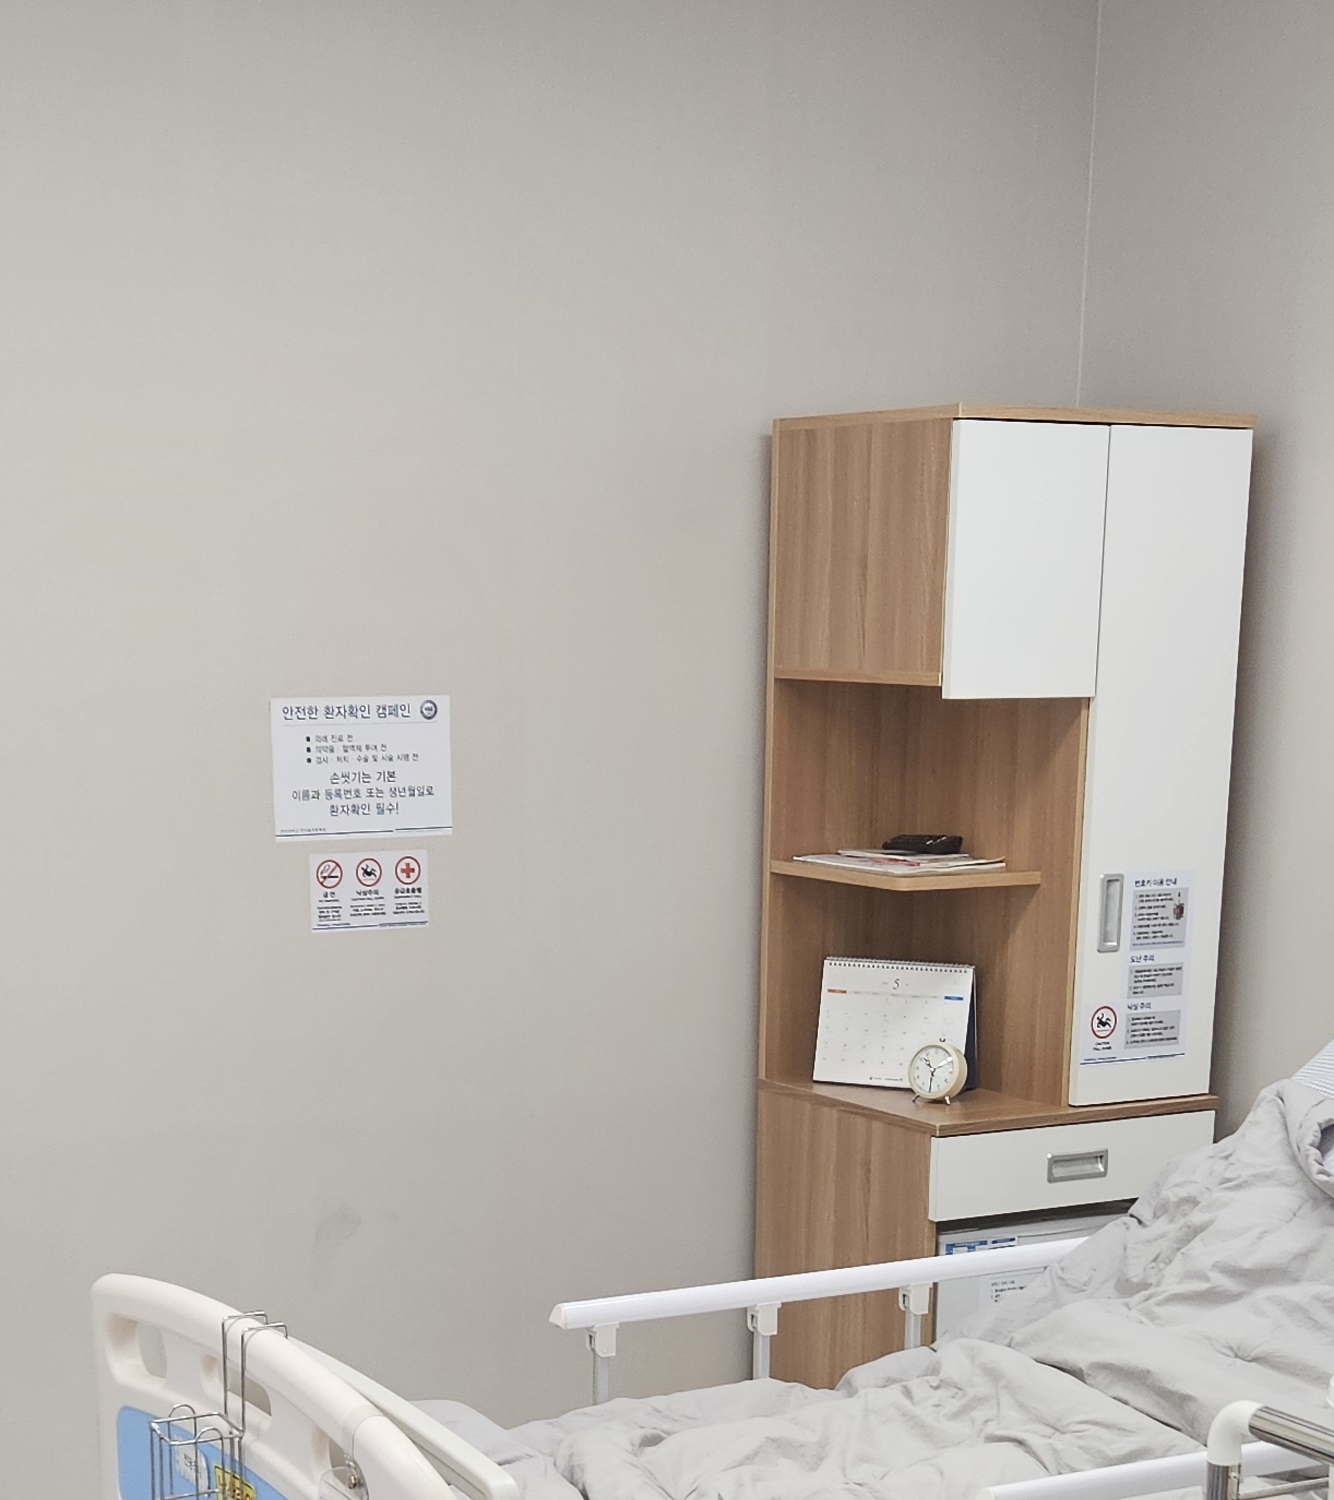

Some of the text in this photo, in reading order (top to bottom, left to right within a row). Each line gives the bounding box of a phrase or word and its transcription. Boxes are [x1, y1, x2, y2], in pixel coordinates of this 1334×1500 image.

[282, 703, 411, 721] 안전한 환자확인 캠페인
[329, 770, 397, 785] 손씻기는 기본
[292, 785, 435, 801] 이름과 등록번호 또는 생년월일로
[329, 802, 400, 817] 환자확인 필수!
[892, 978, 900, 990] 5
